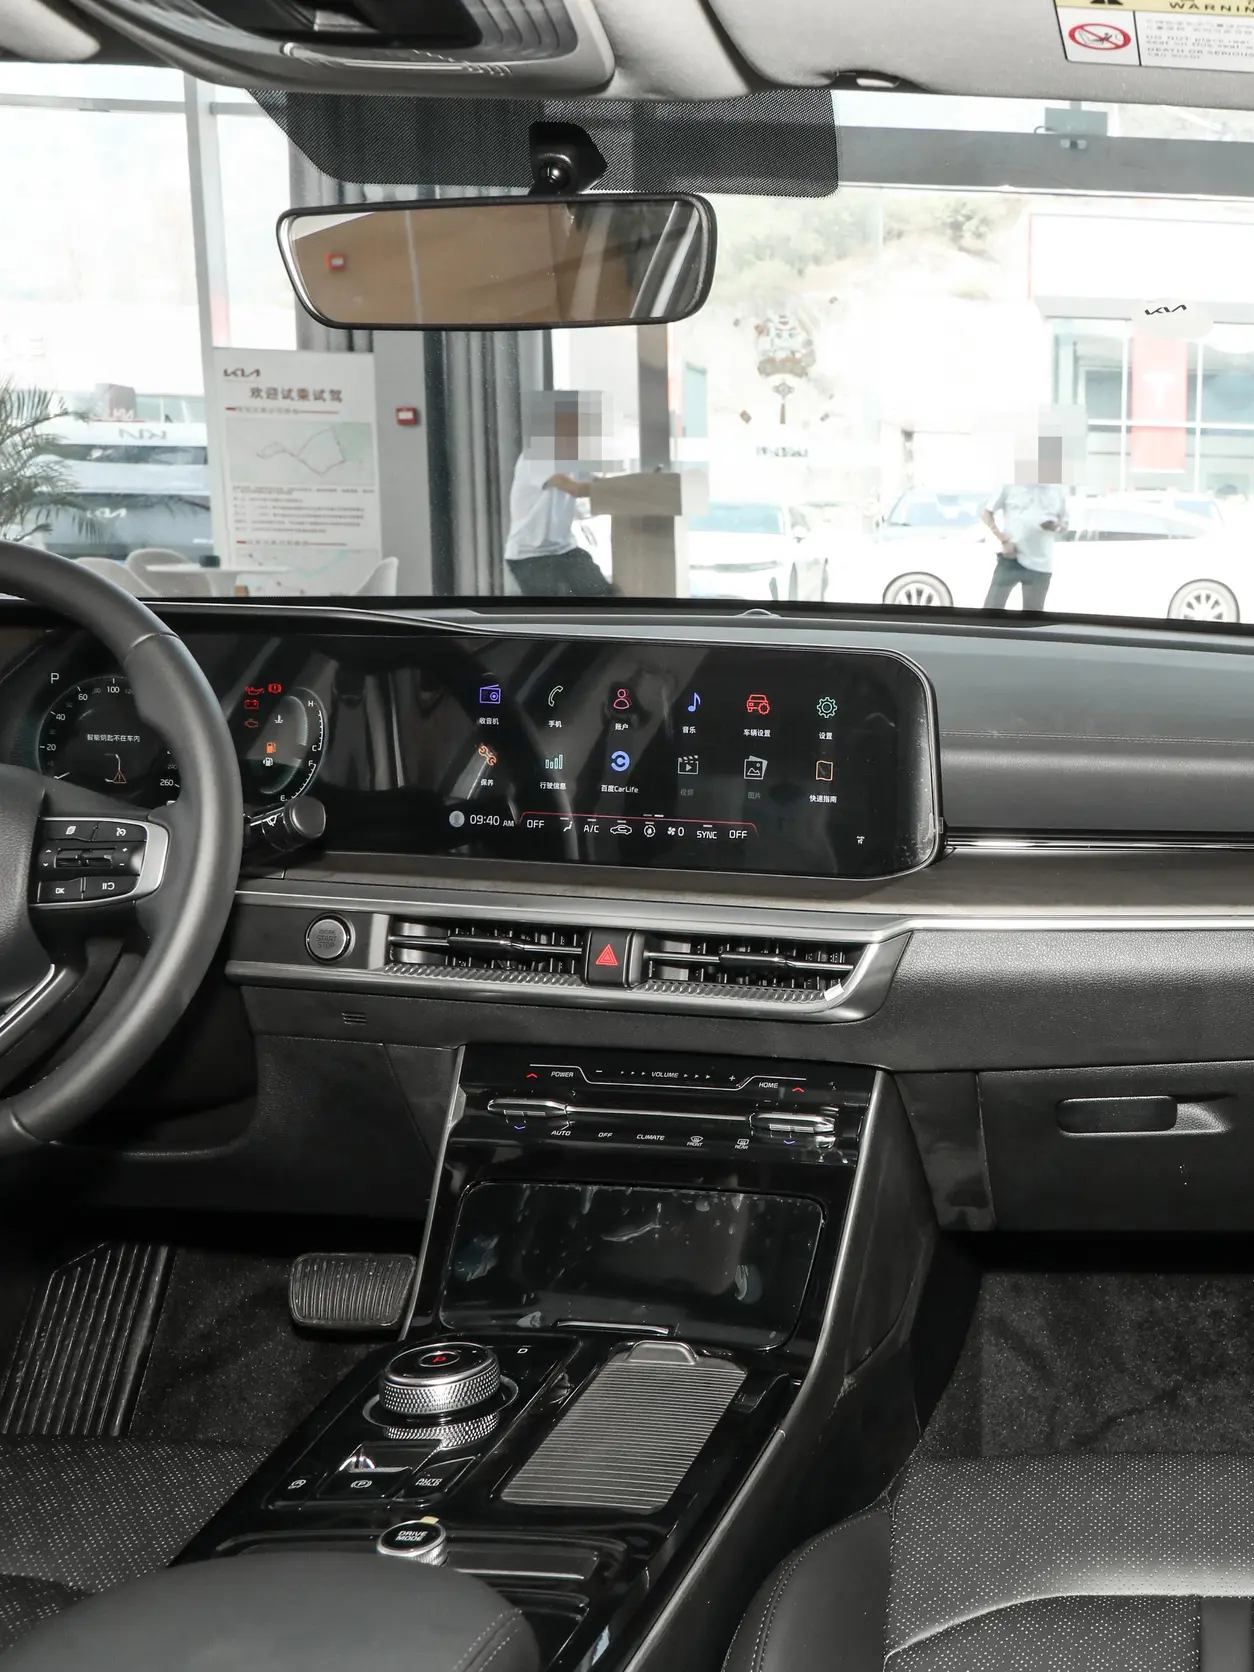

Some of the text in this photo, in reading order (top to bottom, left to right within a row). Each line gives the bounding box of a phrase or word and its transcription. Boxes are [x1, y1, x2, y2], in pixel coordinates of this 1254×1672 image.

[1145, 304, 1187, 316] KIA
[223, 368, 261, 378] KIA
[250, 386, 343, 403] 欢迎试乘试驾
[50, 672, 60, 684] P
[107, 686, 119, 694] 100
[78, 693, 88, 701] 60
[56, 713, 66, 721] 40
[478, 717, 500, 725] 收音机
[548, 720, 562, 728] 手机
[614, 723, 629, 731] 账户
[682, 725, 697, 734] 音乐
[743, 729, 771, 738] 车辆设置
[86, 733, 141, 743] 智能钥匙不在车内
[818, 731, 833, 740] 设置
[46, 743, 57, 751] 20
[159, 779, 174, 787] 260
[480, 778, 494, 787] 保养
[539, 781, 567, 790] 行驶信息
[601, 784, 639, 794] 百度CarLife
[747, 791, 761, 800] 图片
[808, 794, 838, 804] 快速指南
[469, 813, 500, 826] 09:40
[526, 819, 545, 828] OFF
[583, 824, 600, 833] A/C
[677, 826, 685, 837] 0
[696, 830, 718, 839] SYNC
[729, 829, 748, 839] OFF
[55, 887, 65, 895] OK
[316, 934, 337, 943] START
[317, 941, 335, 949] STOP
[651, 1071, 679, 1079] VOLUME
[758, 1081, 779, 1089] HOME
[550, 1129, 572, 1137] AUTO
[636, 1133, 665, 1141] CLIMATE
[433, 1355, 447, 1363] P
